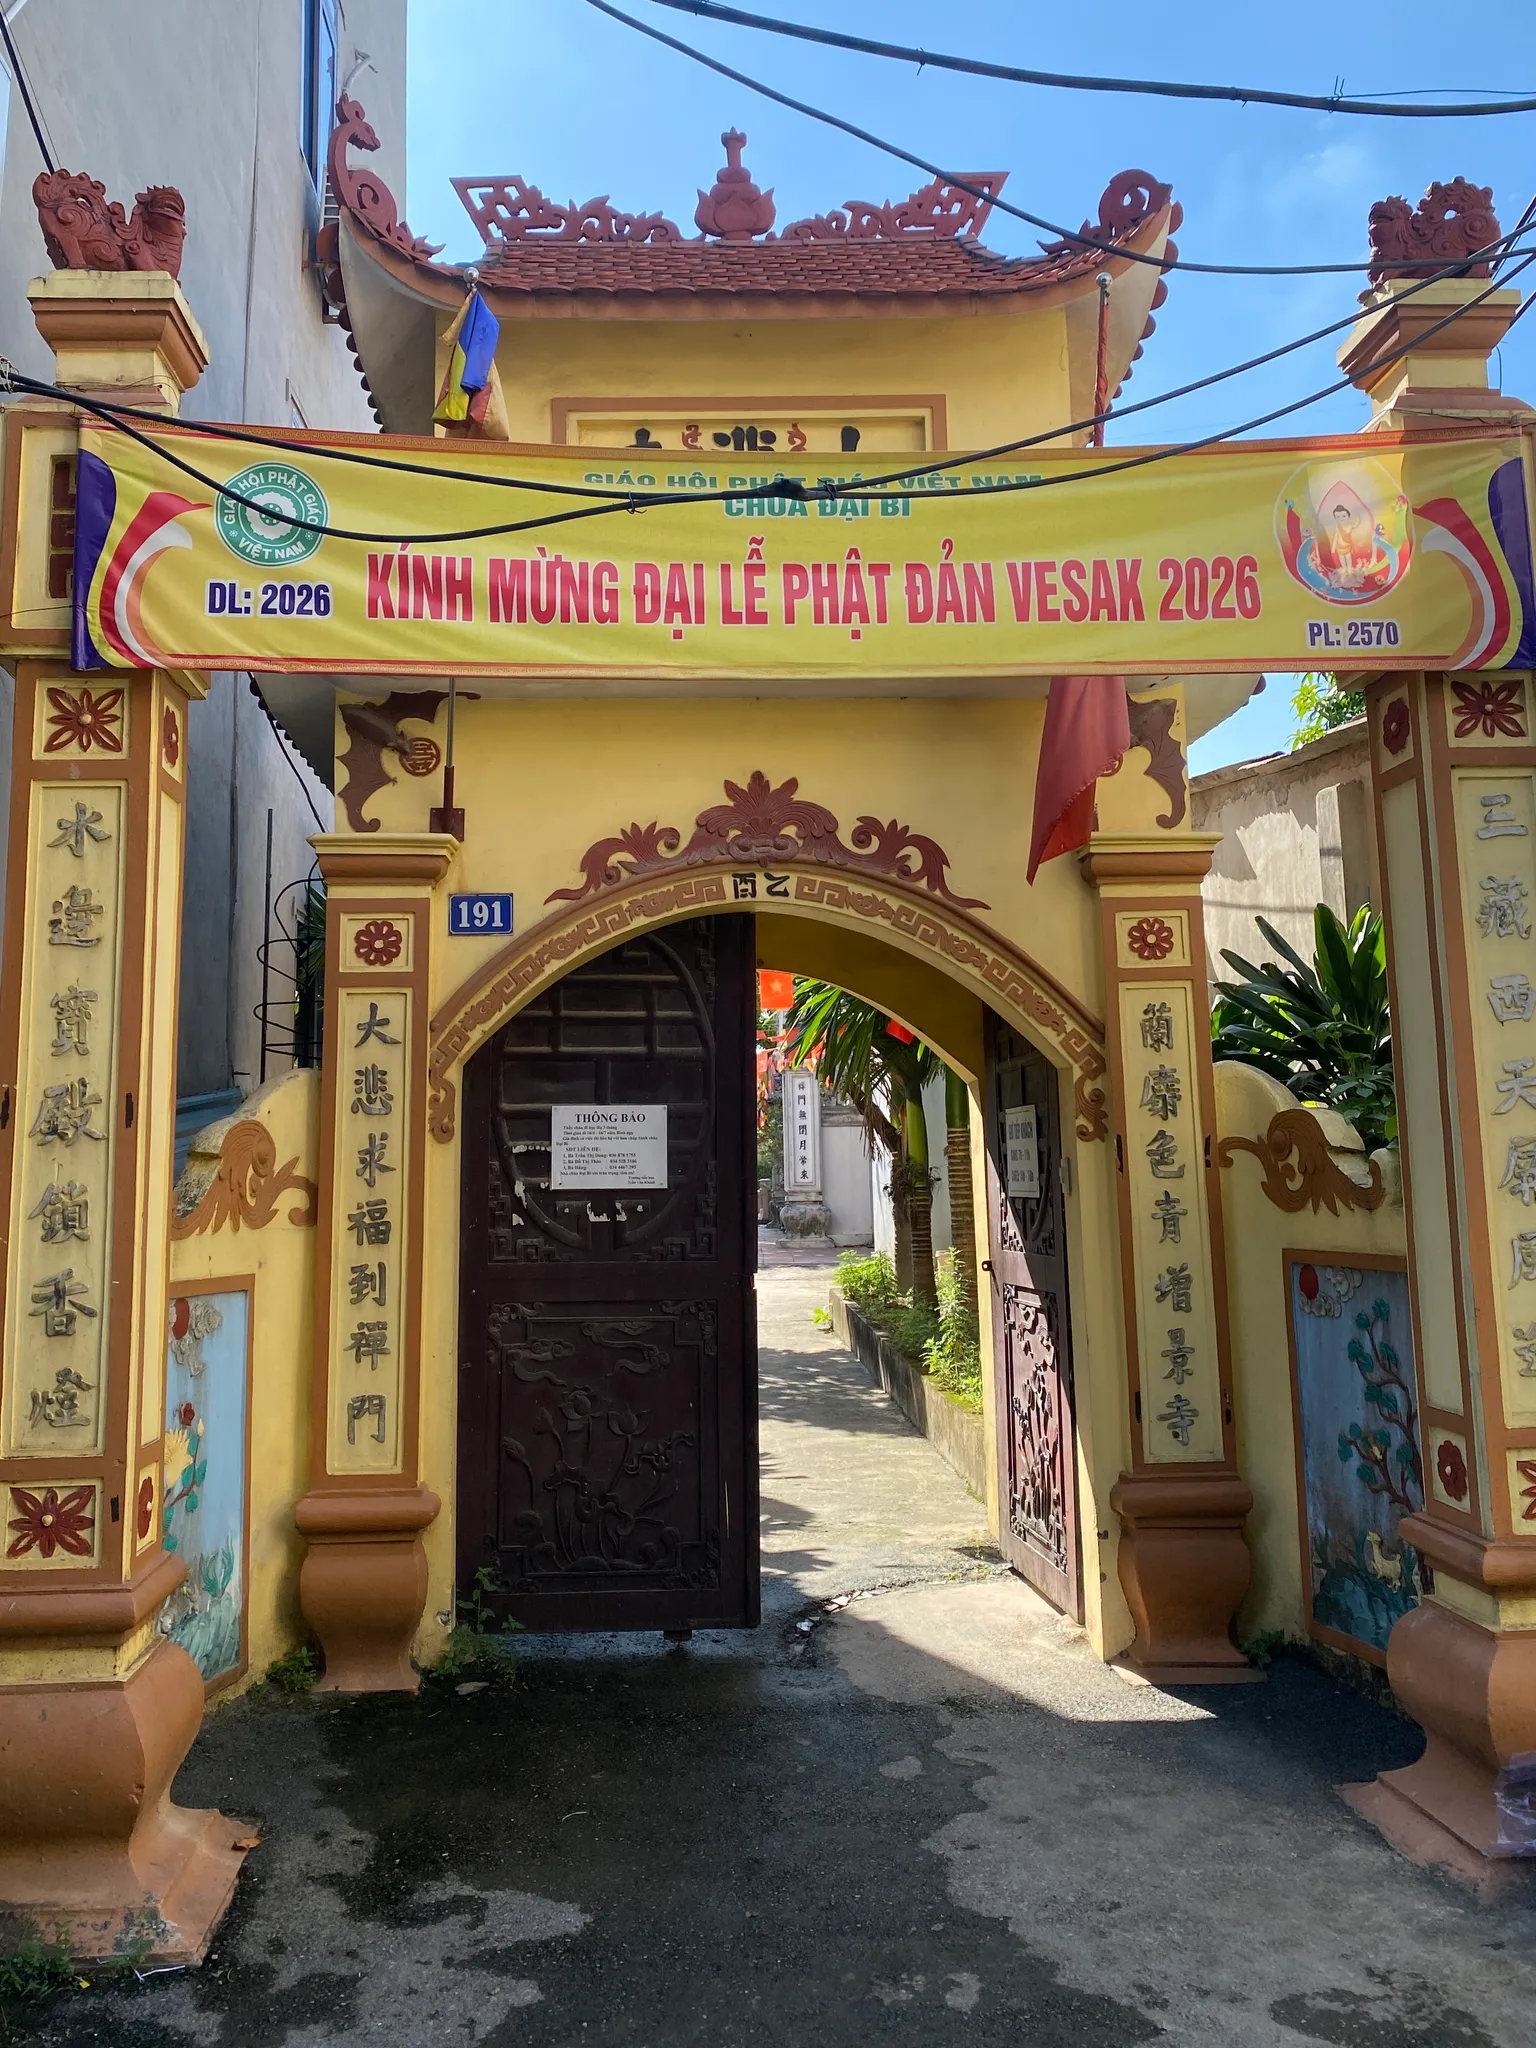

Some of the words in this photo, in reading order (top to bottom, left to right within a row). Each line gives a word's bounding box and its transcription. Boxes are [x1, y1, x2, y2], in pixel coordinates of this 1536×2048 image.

[238, 473, 264, 490] HỘI
[268, 471, 308, 493] PHẬT
[304, 493, 322, 525] GIÁO
[818, 498, 869, 521] ĐẠI
[238, 537, 272, 559] VIỆT
[275, 541, 306, 558] NAM
[208, 582, 251, 614] DL:
[261, 584, 330, 616] 2026
[367, 543, 473, 621] KÍNH
[489, 547, 619, 624] MỪNG
[633, 563, 705, 640] ĐẠI
[720, 536, 768, 625] LỄ
[782, 547, 891, 640] PHẬT
[905, 538, 995, 624] ĐẢN
[1006, 559, 1145, 622] VESAK
[1159, 555, 1261, 620] 2026
[1308, 622, 1341, 646] PL:
[1347, 621, 1399, 646] 2570
[458, 901, 504, 928] 191
[575, 1111, 617, 1123] THÔNG
[621, 1111, 646, 1123] BÁO
